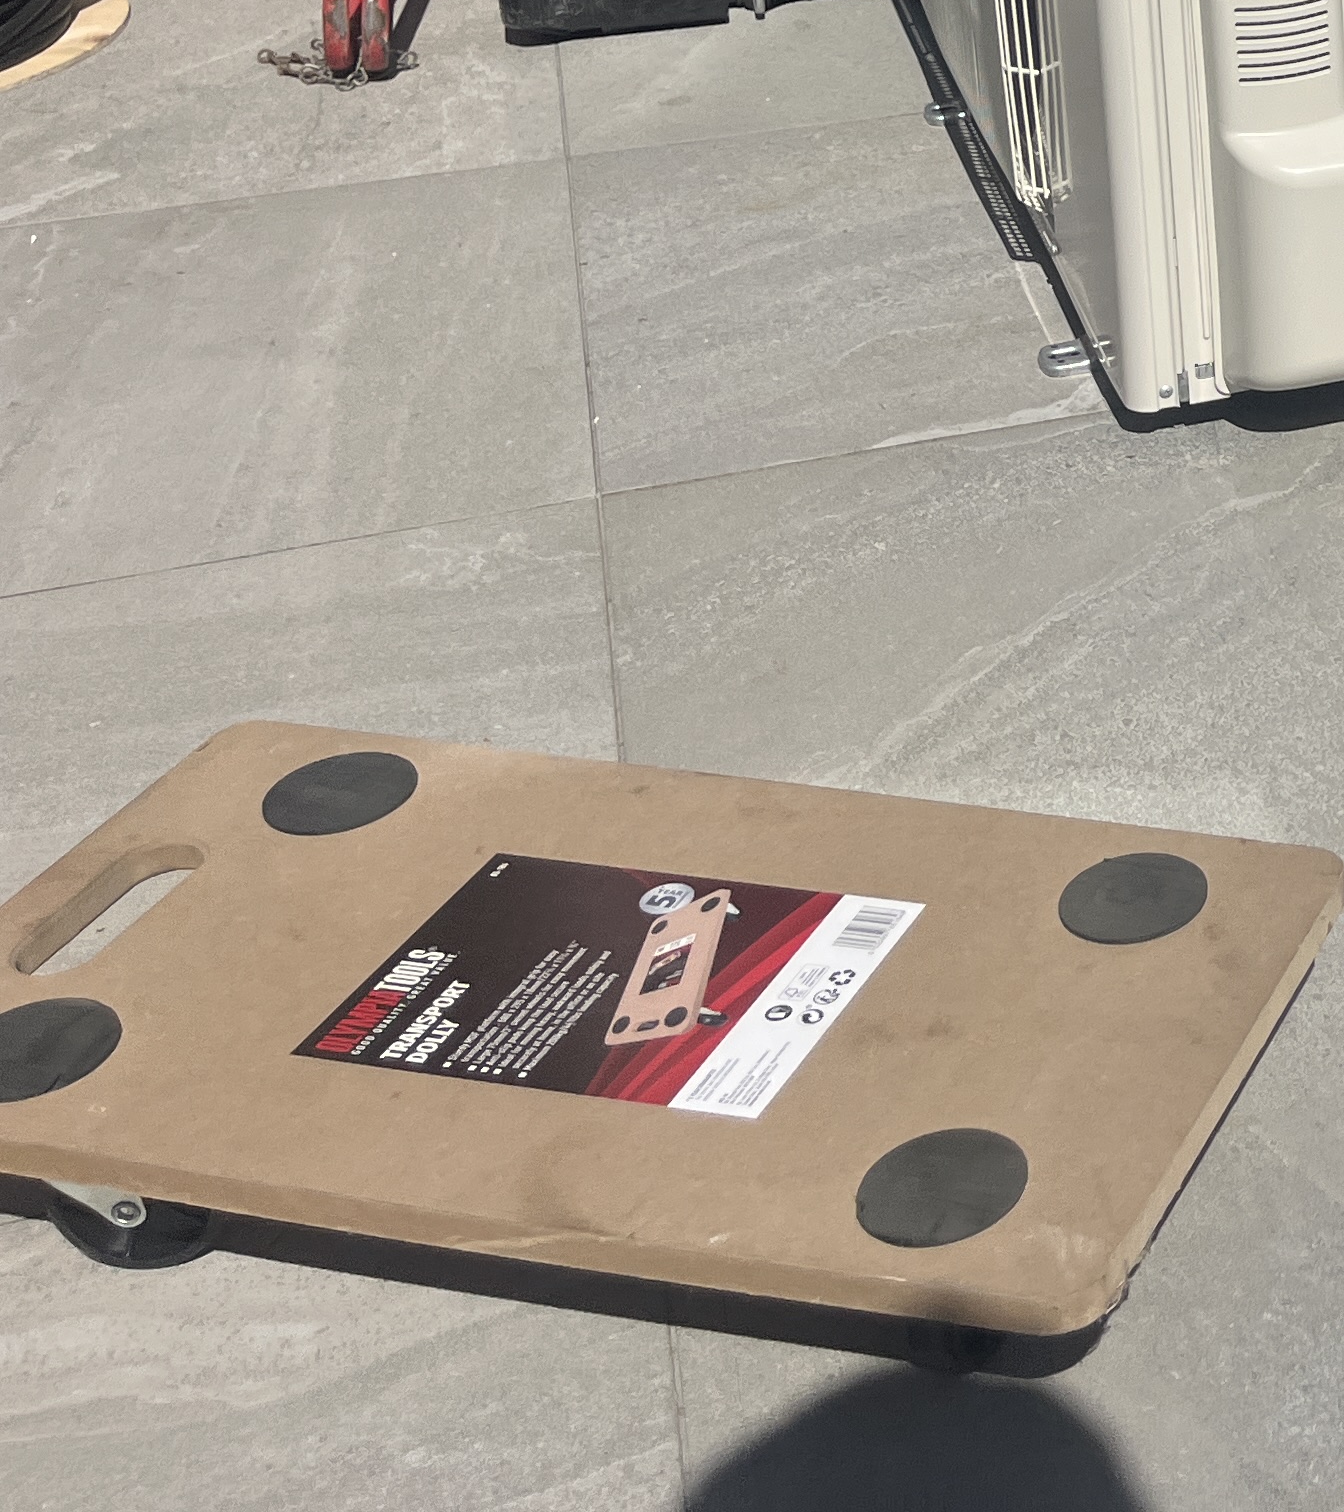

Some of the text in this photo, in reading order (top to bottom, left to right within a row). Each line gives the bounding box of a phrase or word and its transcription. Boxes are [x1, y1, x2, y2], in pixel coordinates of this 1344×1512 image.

[645, 894, 676, 908] 5
[349, 1035, 377, 1055] GOOD
[404, 977, 435, 999] GREAT
[378, 980, 473, 1060] TRANSPORT
[403, 1018, 463, 1063] DOLLY
